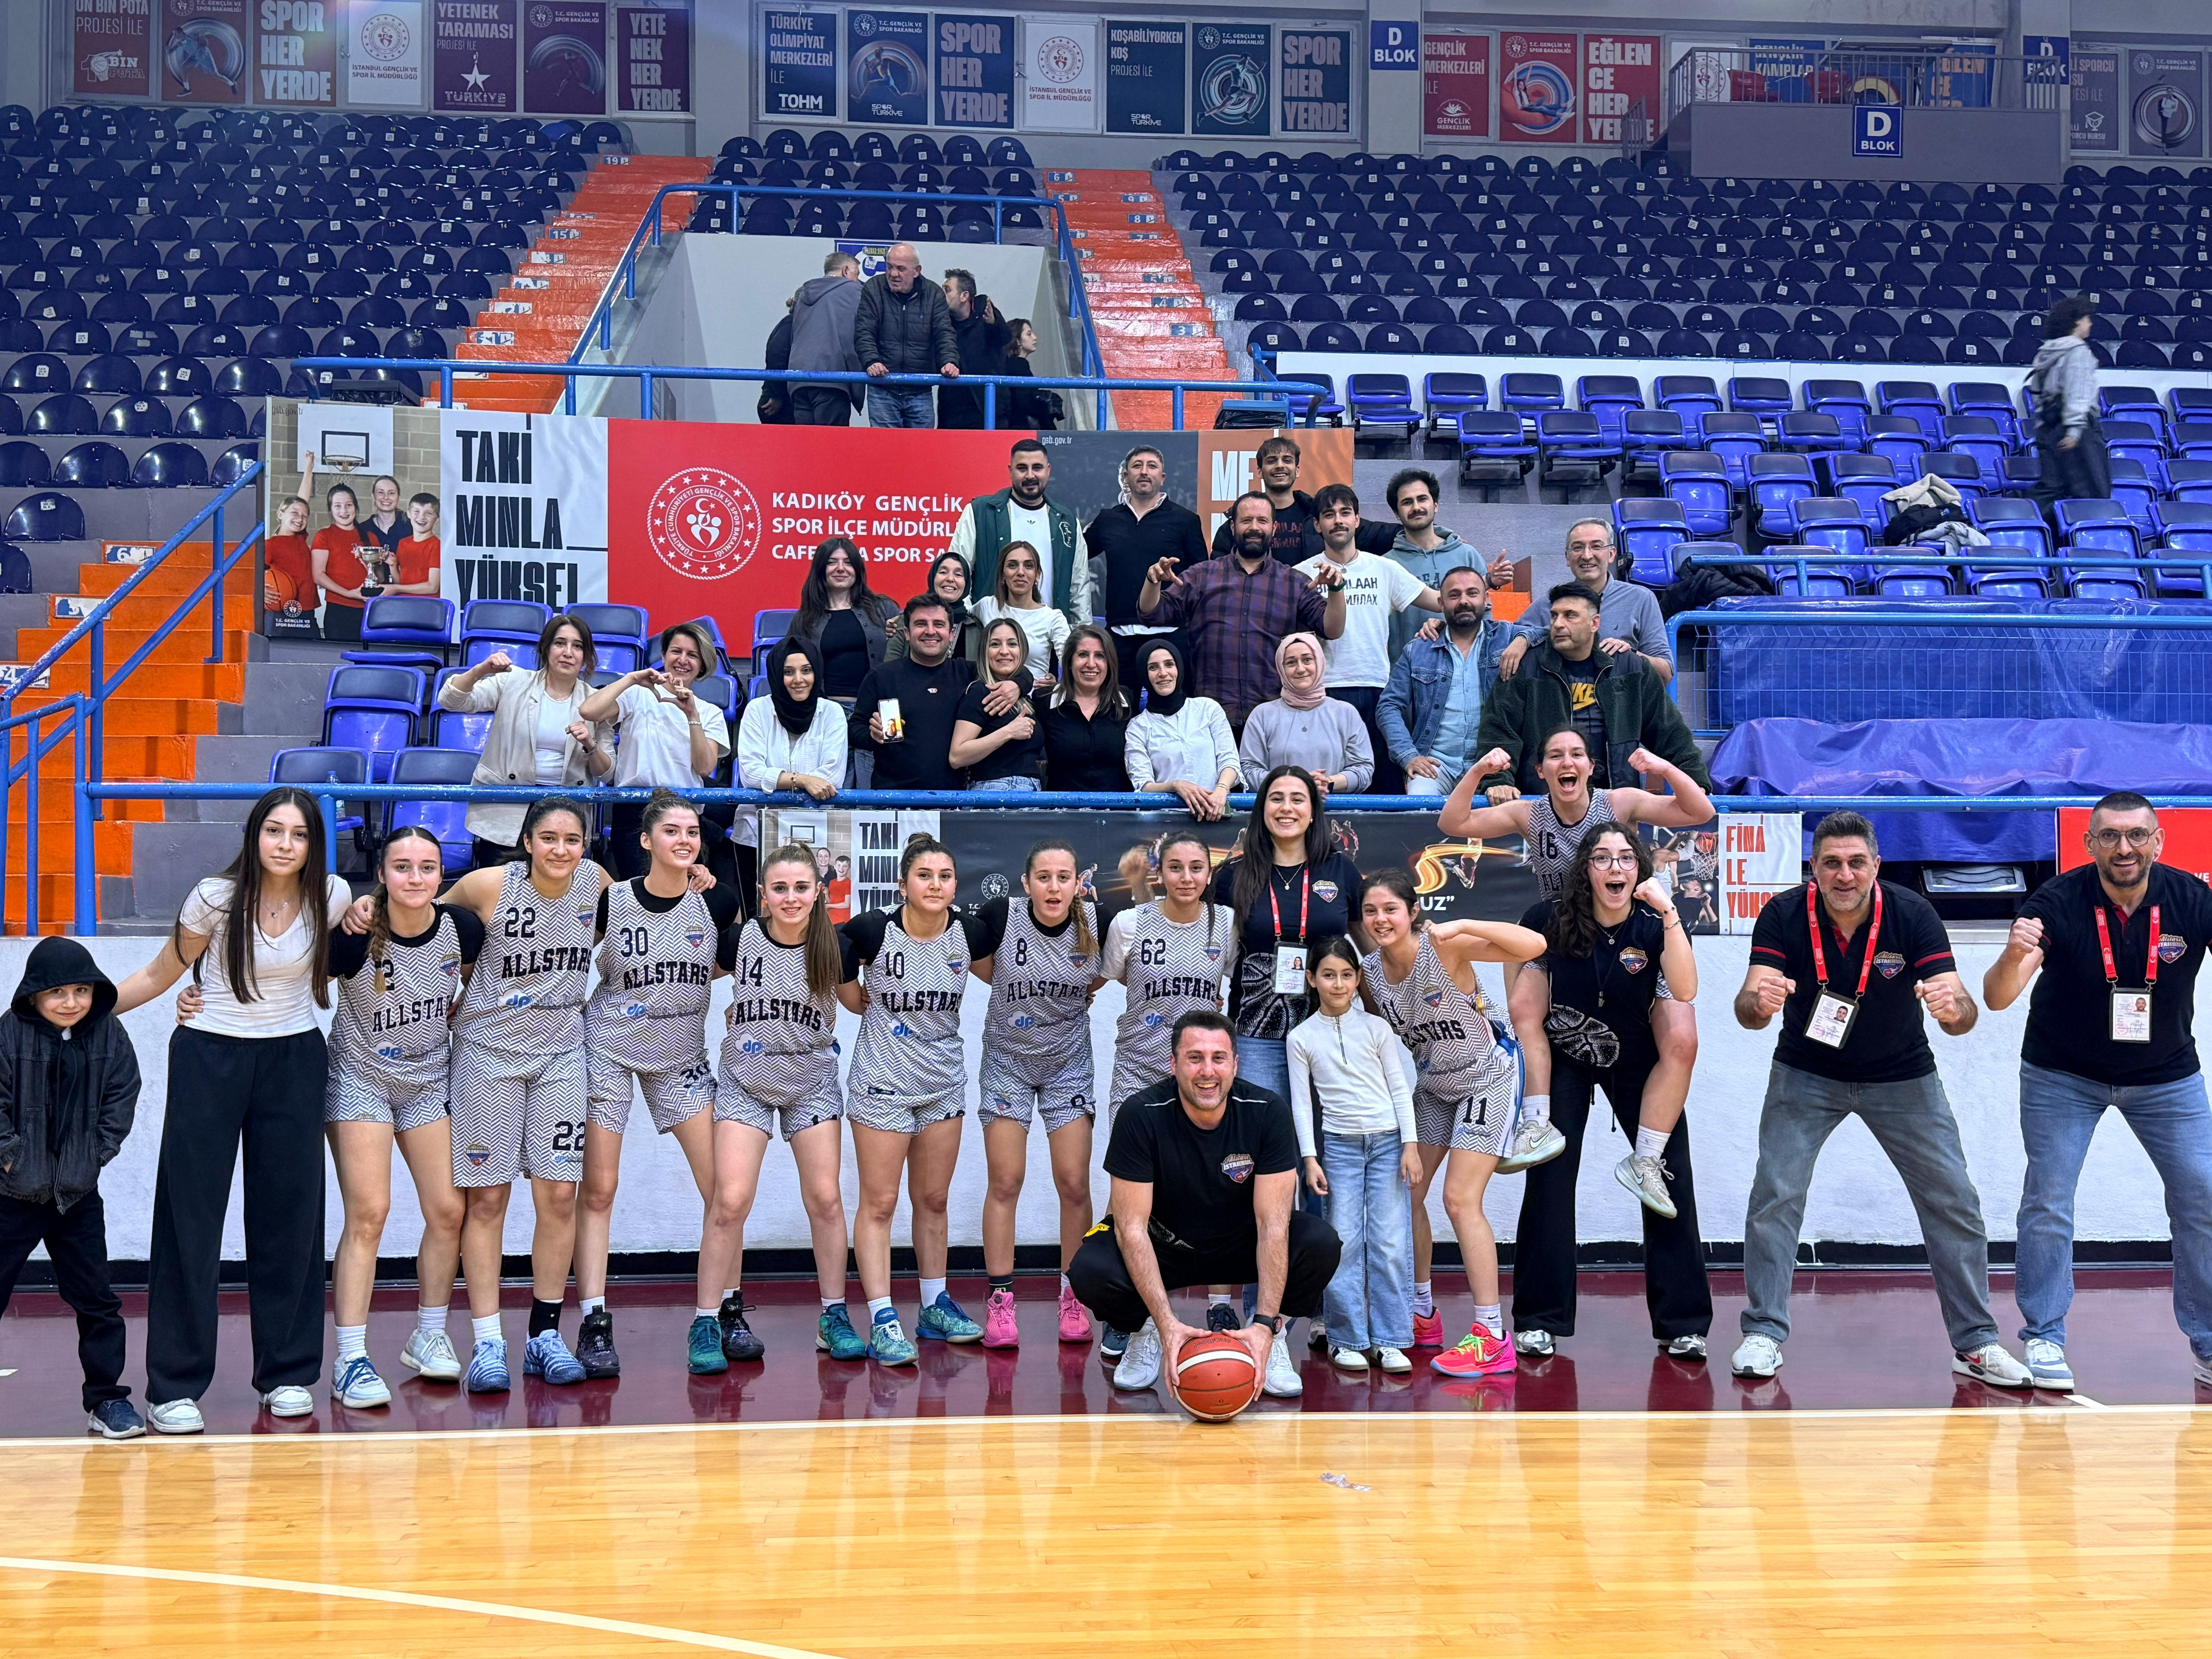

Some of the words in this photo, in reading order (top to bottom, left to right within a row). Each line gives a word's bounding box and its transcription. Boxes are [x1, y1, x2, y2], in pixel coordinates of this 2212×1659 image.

[261, 0, 324, 32] SPOR
[438, 3, 499, 19] YETENEK
[76, 16, 123, 35] PROJESİ
[127, 17, 143, 35] İLE
[437, 22, 514, 39] TARAMASI
[629, 13, 667, 35] YETE
[771, 14, 814, 31] TÜRKİYE
[437, 38, 465, 50] PROJESİ
[770, 32, 825, 49] OLİMPİYAT
[941, 22, 1001, 54] SPOR
[1111, 28, 1183, 44] KOŞABİLİYORKEN
[1389, 28, 1402, 46] D
[261, 35, 305, 66] HER
[630, 38, 663, 60] NEK
[770, 50, 833, 66] MERKEZLERİ
[1111, 47, 1128, 61] KOŞ
[1284, 35, 1341, 66] SPOR
[1374, 50, 1416, 63] BLOK
[1425, 40, 1466, 57] GENÇLİK
[1589, 38, 1652, 66] EĞLEN
[2040, 42, 2053, 57] D
[630, 64, 662, 85] HER
[771, 68, 785, 84] İLE
[941, 57, 982, 87] HER
[1111, 64, 1140, 76] PROJESİ
[1142, 64, 1153, 76] İLE
[1425, 59, 1484, 74] MERKEZLERİ
[2027, 63, 2066, 77] BLOK
[2080, 59, 2115, 72] SPORCU
[260, 70, 331, 102] YERDE
[1284, 68, 1324, 98] HER
[1425, 78, 1439, 94] İLE
[1589, 67, 1615, 90] CE
[629, 89, 682, 111] YERDE
[779, 93, 823, 109] TOHM
[941, 91, 1007, 123] YERDE
[1589, 93, 1629, 115] HER
[1284, 102, 1347, 131] YERDE
[1437, 117, 1470, 125] GENÇLİK
[1867, 111, 1892, 137] D
[1861, 140, 1895, 151] BLOK
[606, 156, 618, 165] 19
[1134, 215, 1141, 223] 8
[553, 230, 567, 239] 15
[1178, 326, 1186, 335] 3
[1042, 435, 1072, 446] gsb.gov.tr
[695, 487, 725, 500] GENÇLİK
[725, 496, 733, 508] VE
[772, 491, 865, 511] KADIKÖY
[876, 493, 963, 516] GENÇLİK
[668, 490, 693, 532] CUMHURİYETİ
[730, 506, 741, 528] SPOR
[456, 495, 563, 550] MINLA
[772, 518, 823, 535] SPOR
[828, 516, 867, 540] İLÇE
[872, 517, 957, 537] MÜDÜRL
[671, 532, 693, 557] TÜRKİYE
[714, 527, 741, 558] BAKANLIĞI
[117, 547, 127, 562] 6
[873, 547, 921, 562] SPOR
[1571, 682, 1594, 702] IKE
[1538, 830, 1558, 860] 16
[1726, 822, 1766, 852] FİNA
[1726, 858, 1748, 885] LE
[2196, 872, 2210, 883] VE
[504, 907, 536, 938] 22
[620, 926, 649, 957] 30
[1015, 938, 1028, 966] 8
[1141, 938, 1166, 965] 62
[501, 947, 592, 979] ALLSTARS
[740, 955, 763, 987] 14
[885, 951, 905, 979] 10
[623, 961, 709, 990] ALLSTARS
[505, 995, 531, 1008] dp
[627, 1003, 646, 1014] dp
[735, 998, 821, 1031] ALLSTARS
[1015, 1016, 1035, 1027] dp
[1382, 999, 1406, 1027] 11
[742, 1040, 763, 1054] dp
[1465, 1096, 1486, 1126] 11
[552, 1121, 585, 1152] 22
